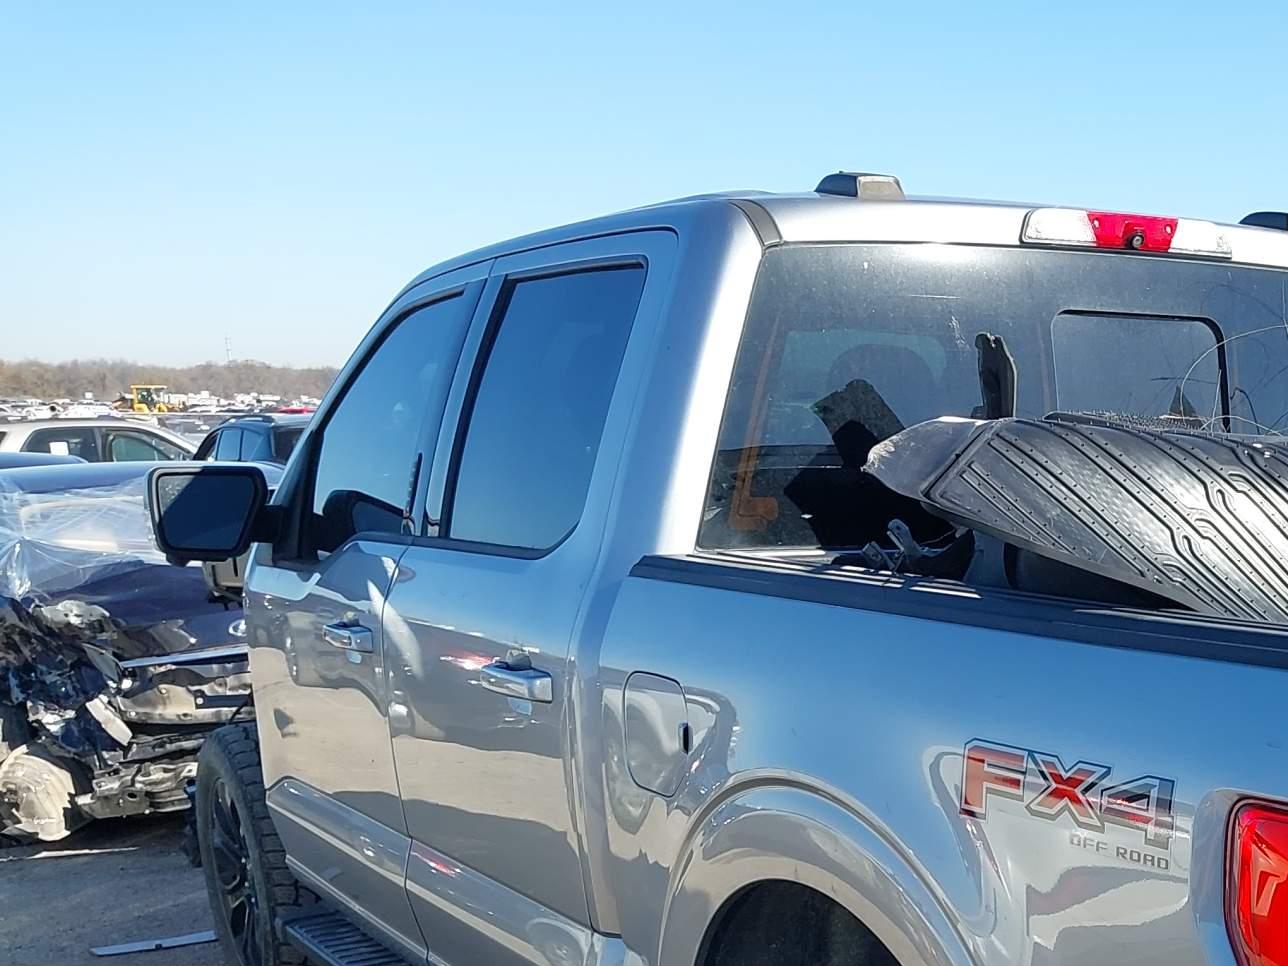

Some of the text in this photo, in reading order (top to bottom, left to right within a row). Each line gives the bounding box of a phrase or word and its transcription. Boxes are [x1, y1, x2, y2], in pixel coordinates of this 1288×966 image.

[959, 737, 1176, 851] FX4
[1068, 832, 1170, 870] OFF ROAD
